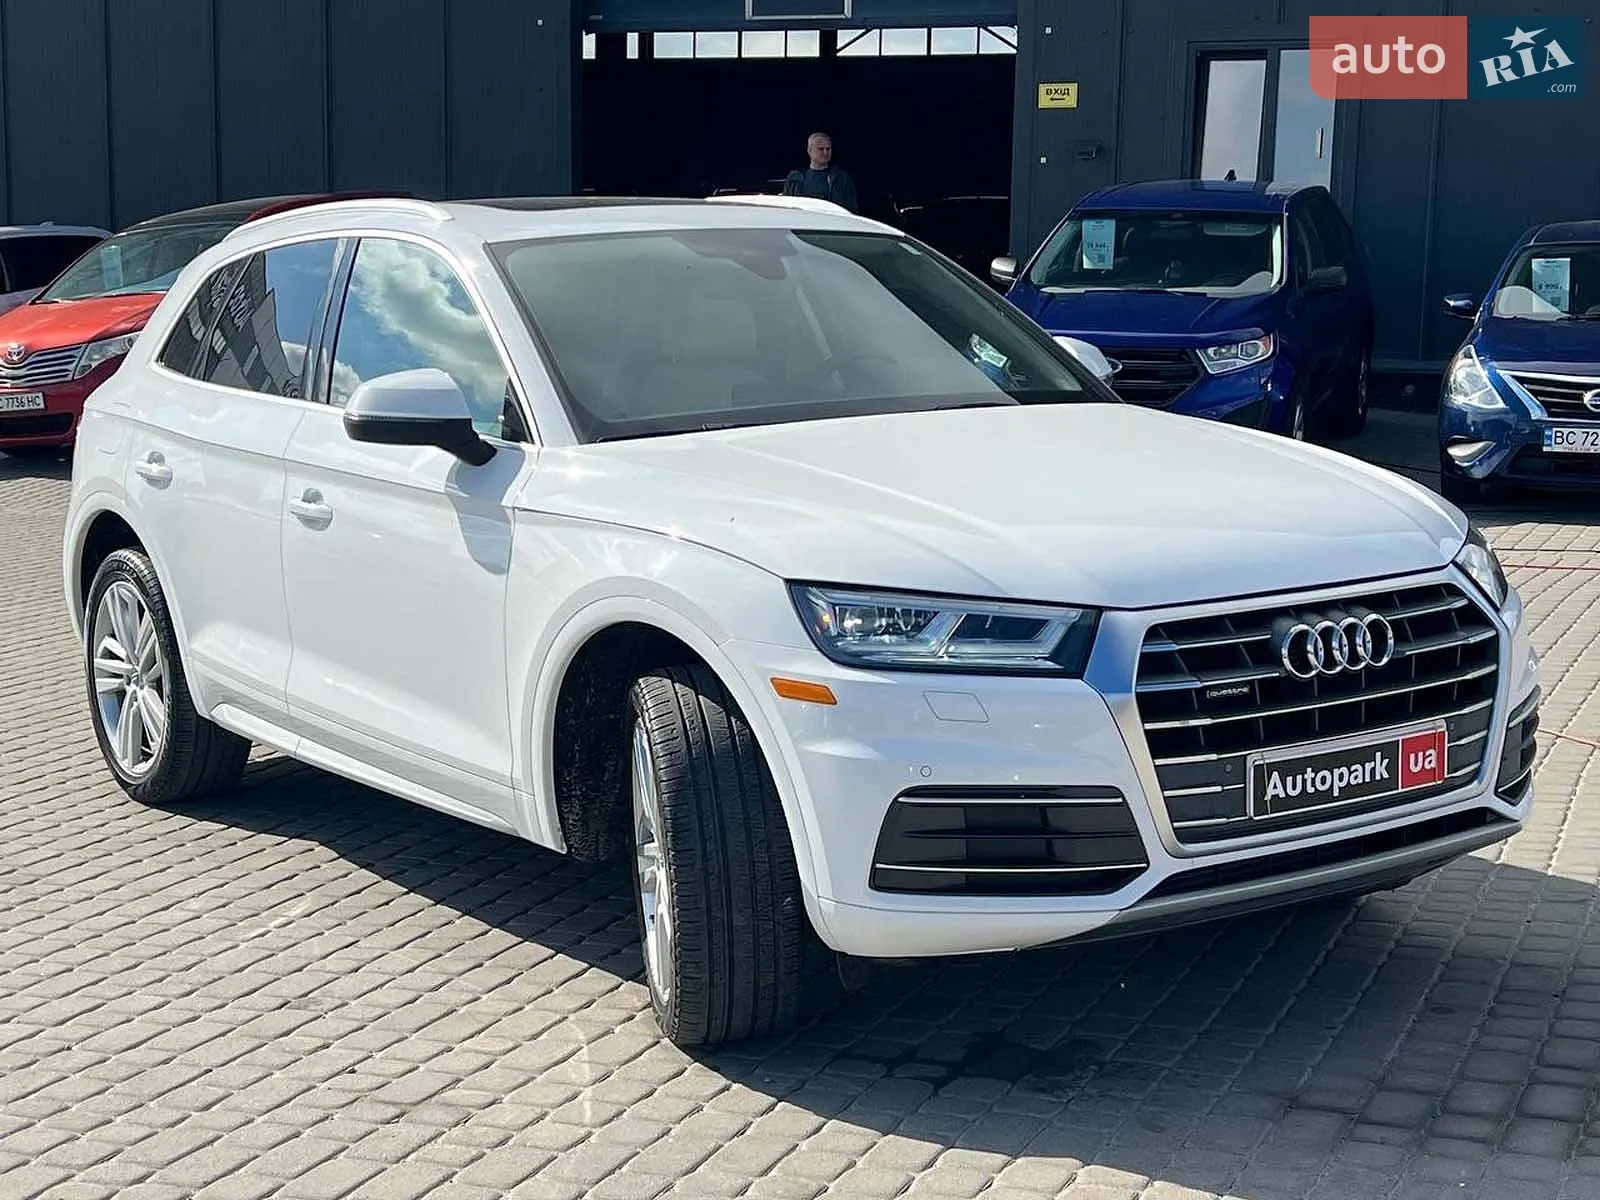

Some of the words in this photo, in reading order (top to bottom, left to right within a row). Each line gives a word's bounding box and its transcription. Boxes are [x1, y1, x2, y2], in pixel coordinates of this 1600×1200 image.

[1554, 430, 1576, 446] BC
[1265, 751, 1390, 800] Autopark
[1409, 748, 1438, 773] ua
